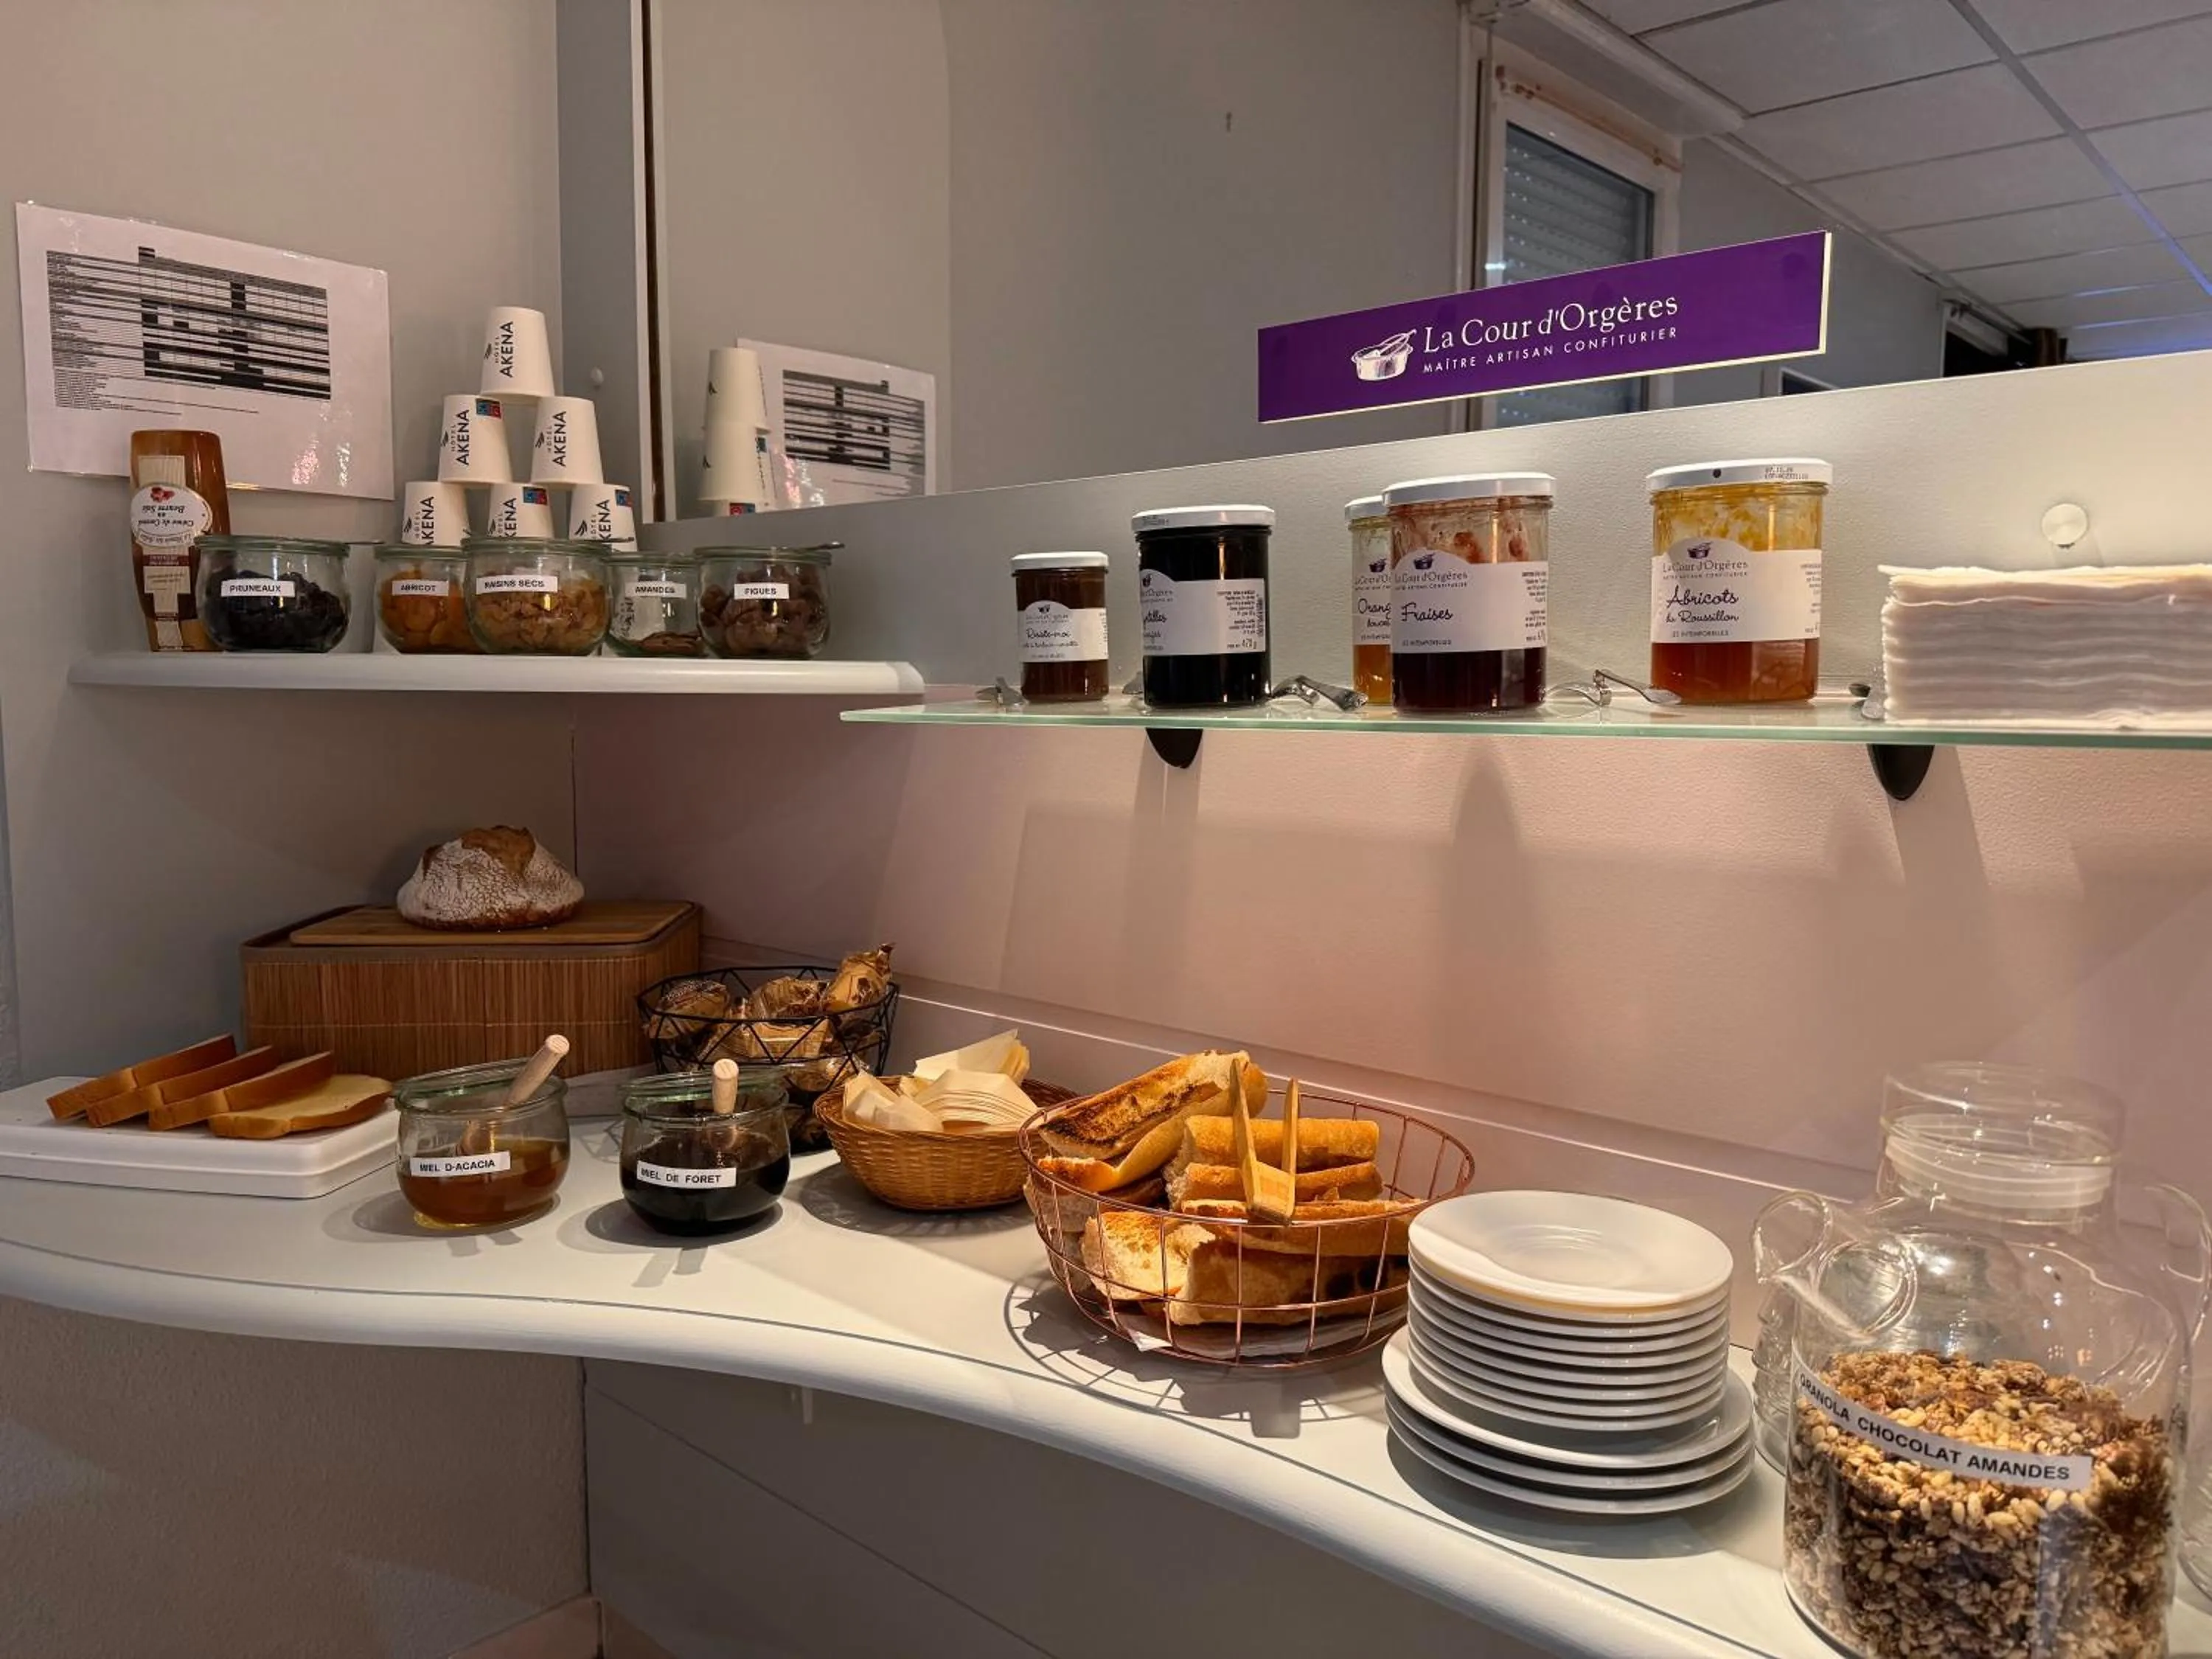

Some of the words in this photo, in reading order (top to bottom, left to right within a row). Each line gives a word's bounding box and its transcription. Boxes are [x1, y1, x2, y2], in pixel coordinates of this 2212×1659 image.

[1423, 326, 1454, 353] La
[1461, 319, 1532, 347] Cour
[1538, 296, 1678, 334] d'Orgères
[500, 321, 514, 378] AKENA
[1423, 356, 1476, 374] MAÎTRE
[1486, 345, 1554, 365] ARTISAN
[1564, 327, 1677, 354] CONFITURIER
[456, 409, 470, 466] AKENA
[553, 411, 567, 467] AKENA
[503, 497, 517, 537] KENA
[597, 498, 611, 542] KENA
[229, 584, 282, 593] PRUNEAUX
[400, 584, 437, 592] ABRICOT
[484, 580, 516, 589] RAISINS
[518, 579, 546, 588] SECS
[744, 587, 776, 596] FIGUES
[1666, 584, 1739, 608] Abricots
[1357, 598, 1391, 620] Orang
[1401, 601, 1453, 622] Fraises
[1677, 610, 1739, 623] Roussillon
[666, 1173, 680, 1182] DE
[685, 1175, 722, 1183] FORET
[1799, 1372, 1851, 1423] GRANOLA
[1857, 1416, 1962, 1465] CHOCOLAT
[1966, 1454, 2070, 1481] AMANDES
